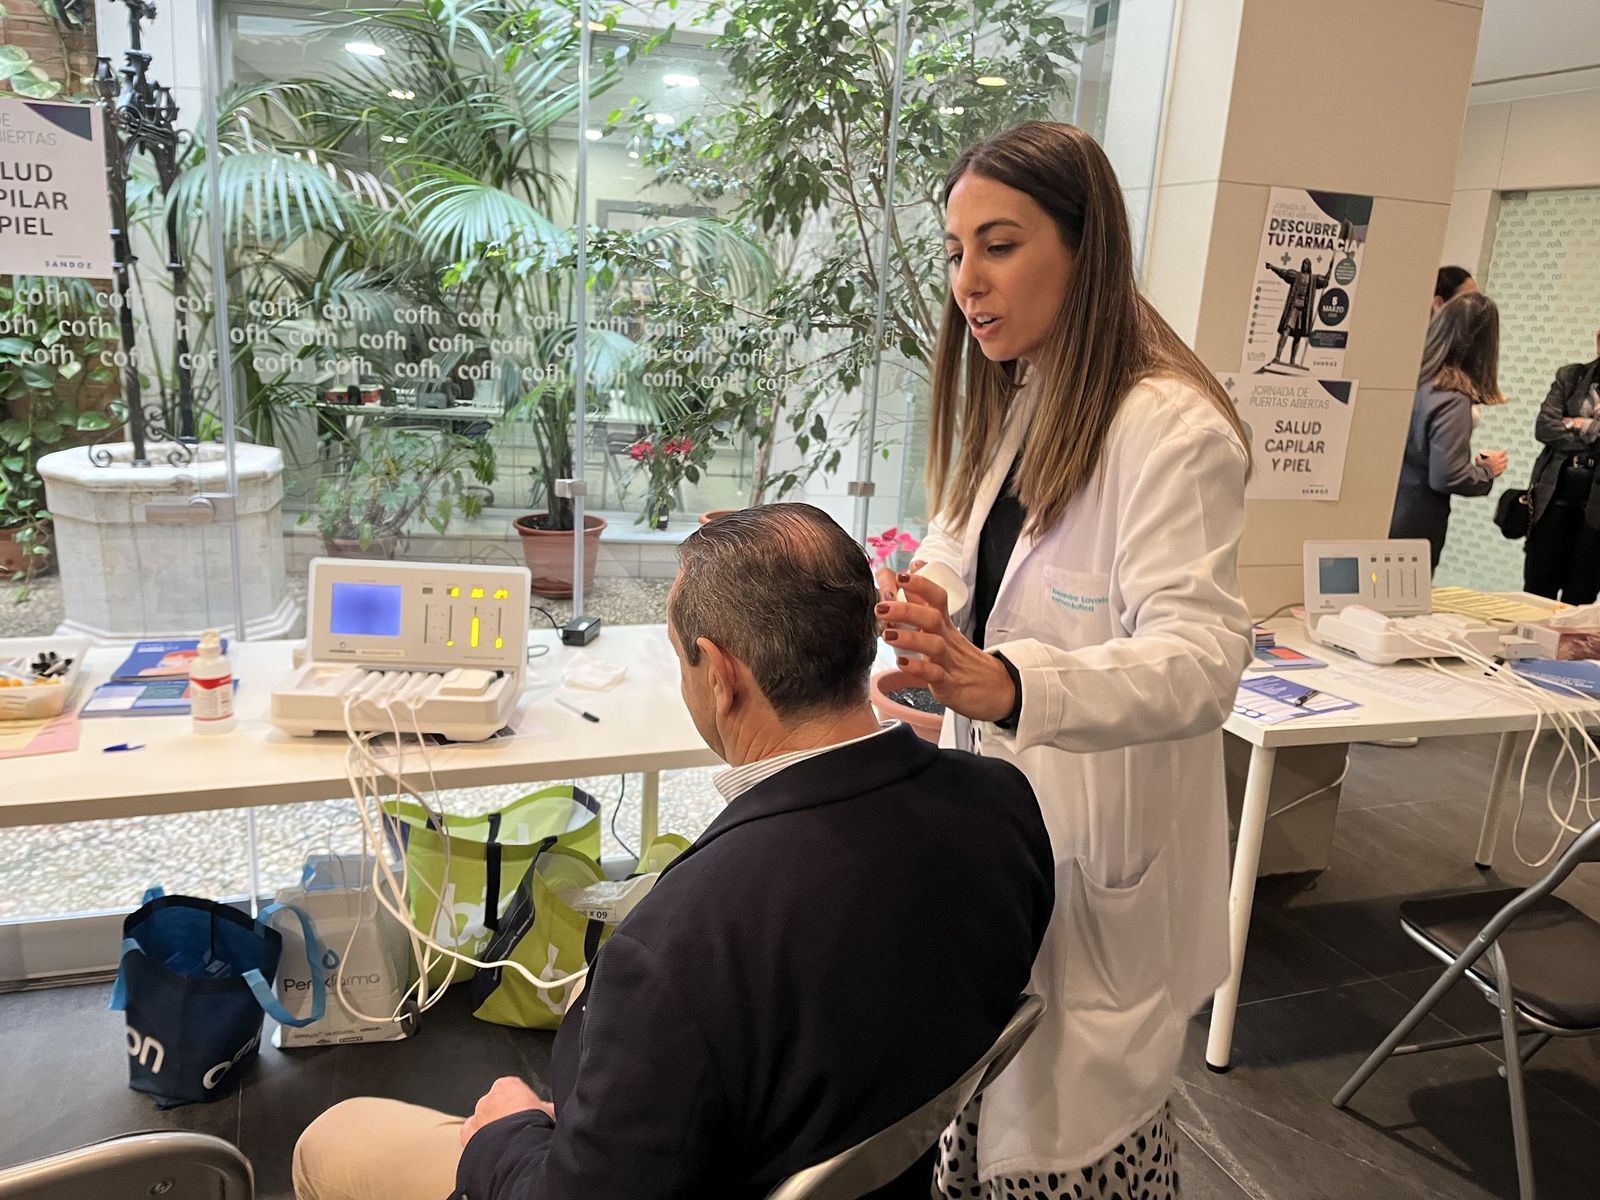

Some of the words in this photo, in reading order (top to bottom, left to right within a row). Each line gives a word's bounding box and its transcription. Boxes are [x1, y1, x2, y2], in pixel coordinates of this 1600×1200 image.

[0, 113, 10, 127] E
[0, 129, 57, 146] IERTAS
[0, 216, 53, 236] PIEL
[1270, 218, 1338, 236] DESCUBRE
[1268, 232, 1286, 246] TU
[45, 260, 92, 269] SANDOZ
[16, 285, 70, 306] cofh
[96, 288, 136, 310] cof
[175, 292, 214, 312] cof
[249, 296, 300, 318] cofh
[322, 300, 372, 322] cofh
[393, 304, 440, 325] cofh
[457, 308, 500, 328] cofh
[523, 312, 566, 331] cofh
[586, 316, 629, 334] cofh
[59, 316, 112, 338] cofh
[230, 324, 269, 345] ofh
[288, 326, 338, 347] cofh
[359, 330, 407, 351] cofh
[428, 334, 474, 354] cofh
[490, 337, 535, 358] cofh
[673, 346, 713, 364] cofh
[730, 349, 767, 367] cofh
[21, 343, 74, 365] cofh
[100, 346, 143, 369] cof
[179, 350, 218, 370] cof
[253, 354, 303, 374] cofh
[324, 356, 373, 377] cofh
[394, 357, 442, 378] cofh
[458, 360, 500, 381] cofh
[523, 363, 566, 382] cofh
[642, 369, 683, 388] cofh
[1253, 385, 1295, 397] JORNADA
[1297, 387, 1311, 398] DE
[1249, 396, 1288, 408] PUERTAS
[1290, 399, 1330, 410] ABIERTAS
[1275, 420, 1322, 435] SALUD
[1265, 439, 1325, 454] CAPILAR
[1272, 458, 1281, 472] Y
[1283, 458, 1312, 473] PIEL
